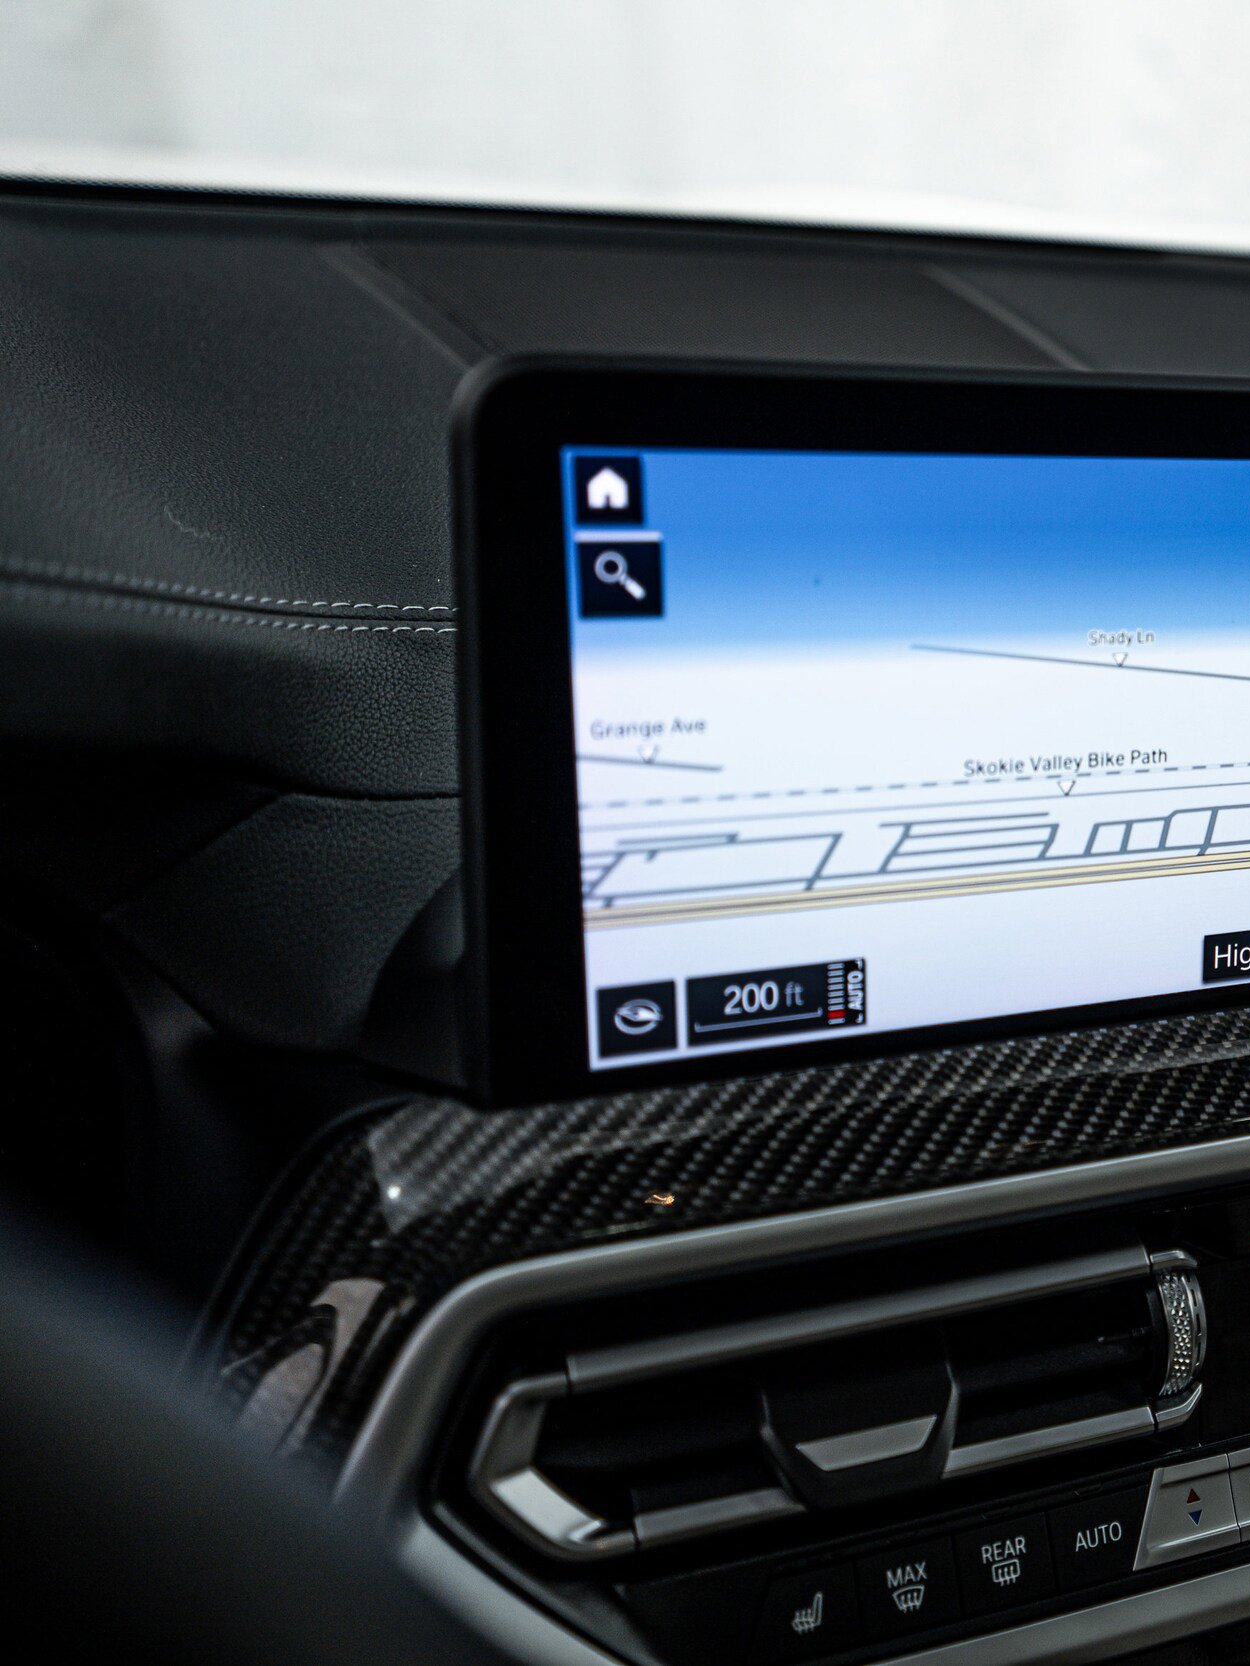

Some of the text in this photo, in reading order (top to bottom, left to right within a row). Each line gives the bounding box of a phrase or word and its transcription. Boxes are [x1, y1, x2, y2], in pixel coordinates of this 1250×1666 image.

[1088, 630, 1155, 647] Shady Ln
[590, 716, 707, 740] Grange Ave
[963, 748, 1168, 777] Skokie Valley Bike Path
[723, 980, 805, 1016] 200 ft
[847, 970, 864, 1012] AUTO
[981, 1535, 1027, 1564] REAR
[1075, 1521, 1123, 1552] AUTO
[886, 1560, 928, 1589] MAX
